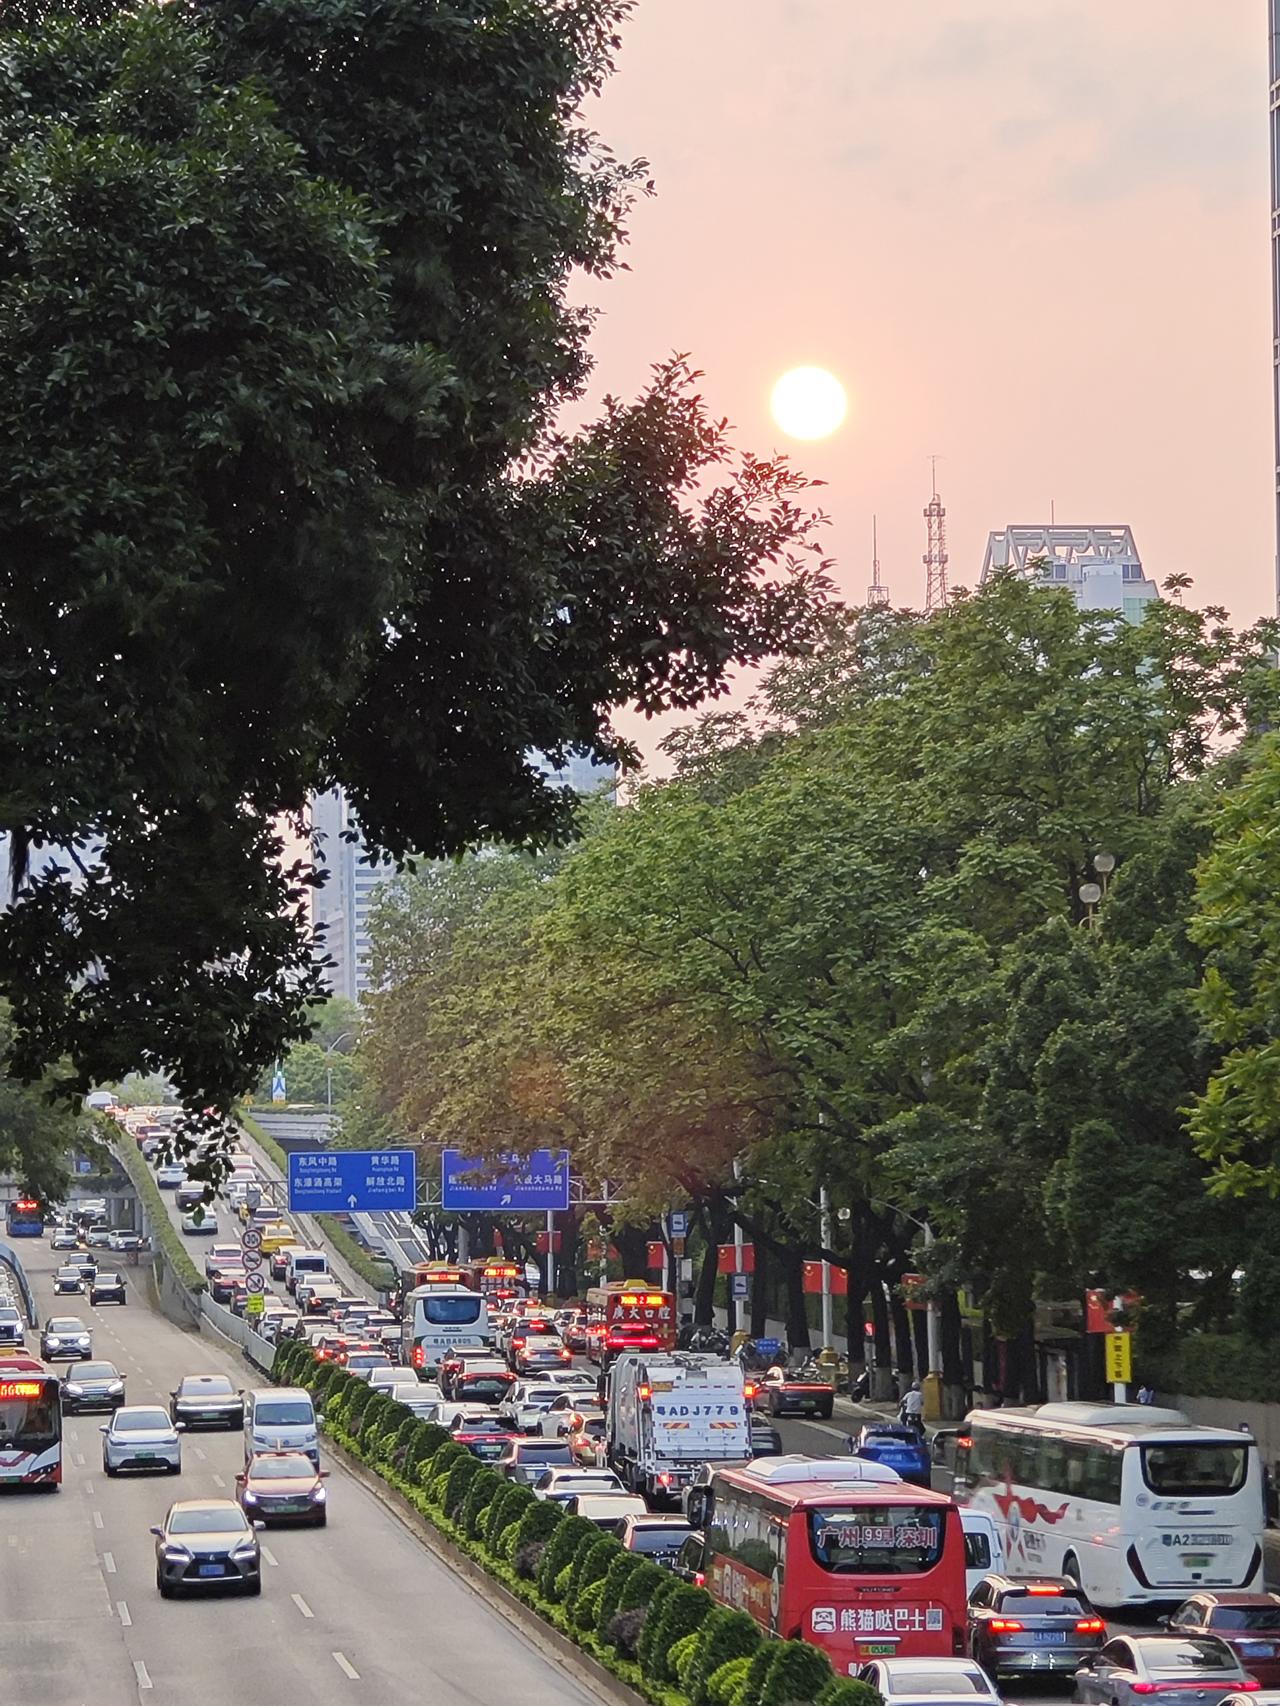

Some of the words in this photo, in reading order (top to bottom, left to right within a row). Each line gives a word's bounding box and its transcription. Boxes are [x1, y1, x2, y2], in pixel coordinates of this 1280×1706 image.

[298, 1156, 337, 1167] 东风中路
[366, 1176, 405, 1187] 解放北路
[817, 1526, 860, 1549] 广州
[896, 1526, 937, 1549] 深圳
[840, 1608, 925, 1632] 熊猫哒巴士
